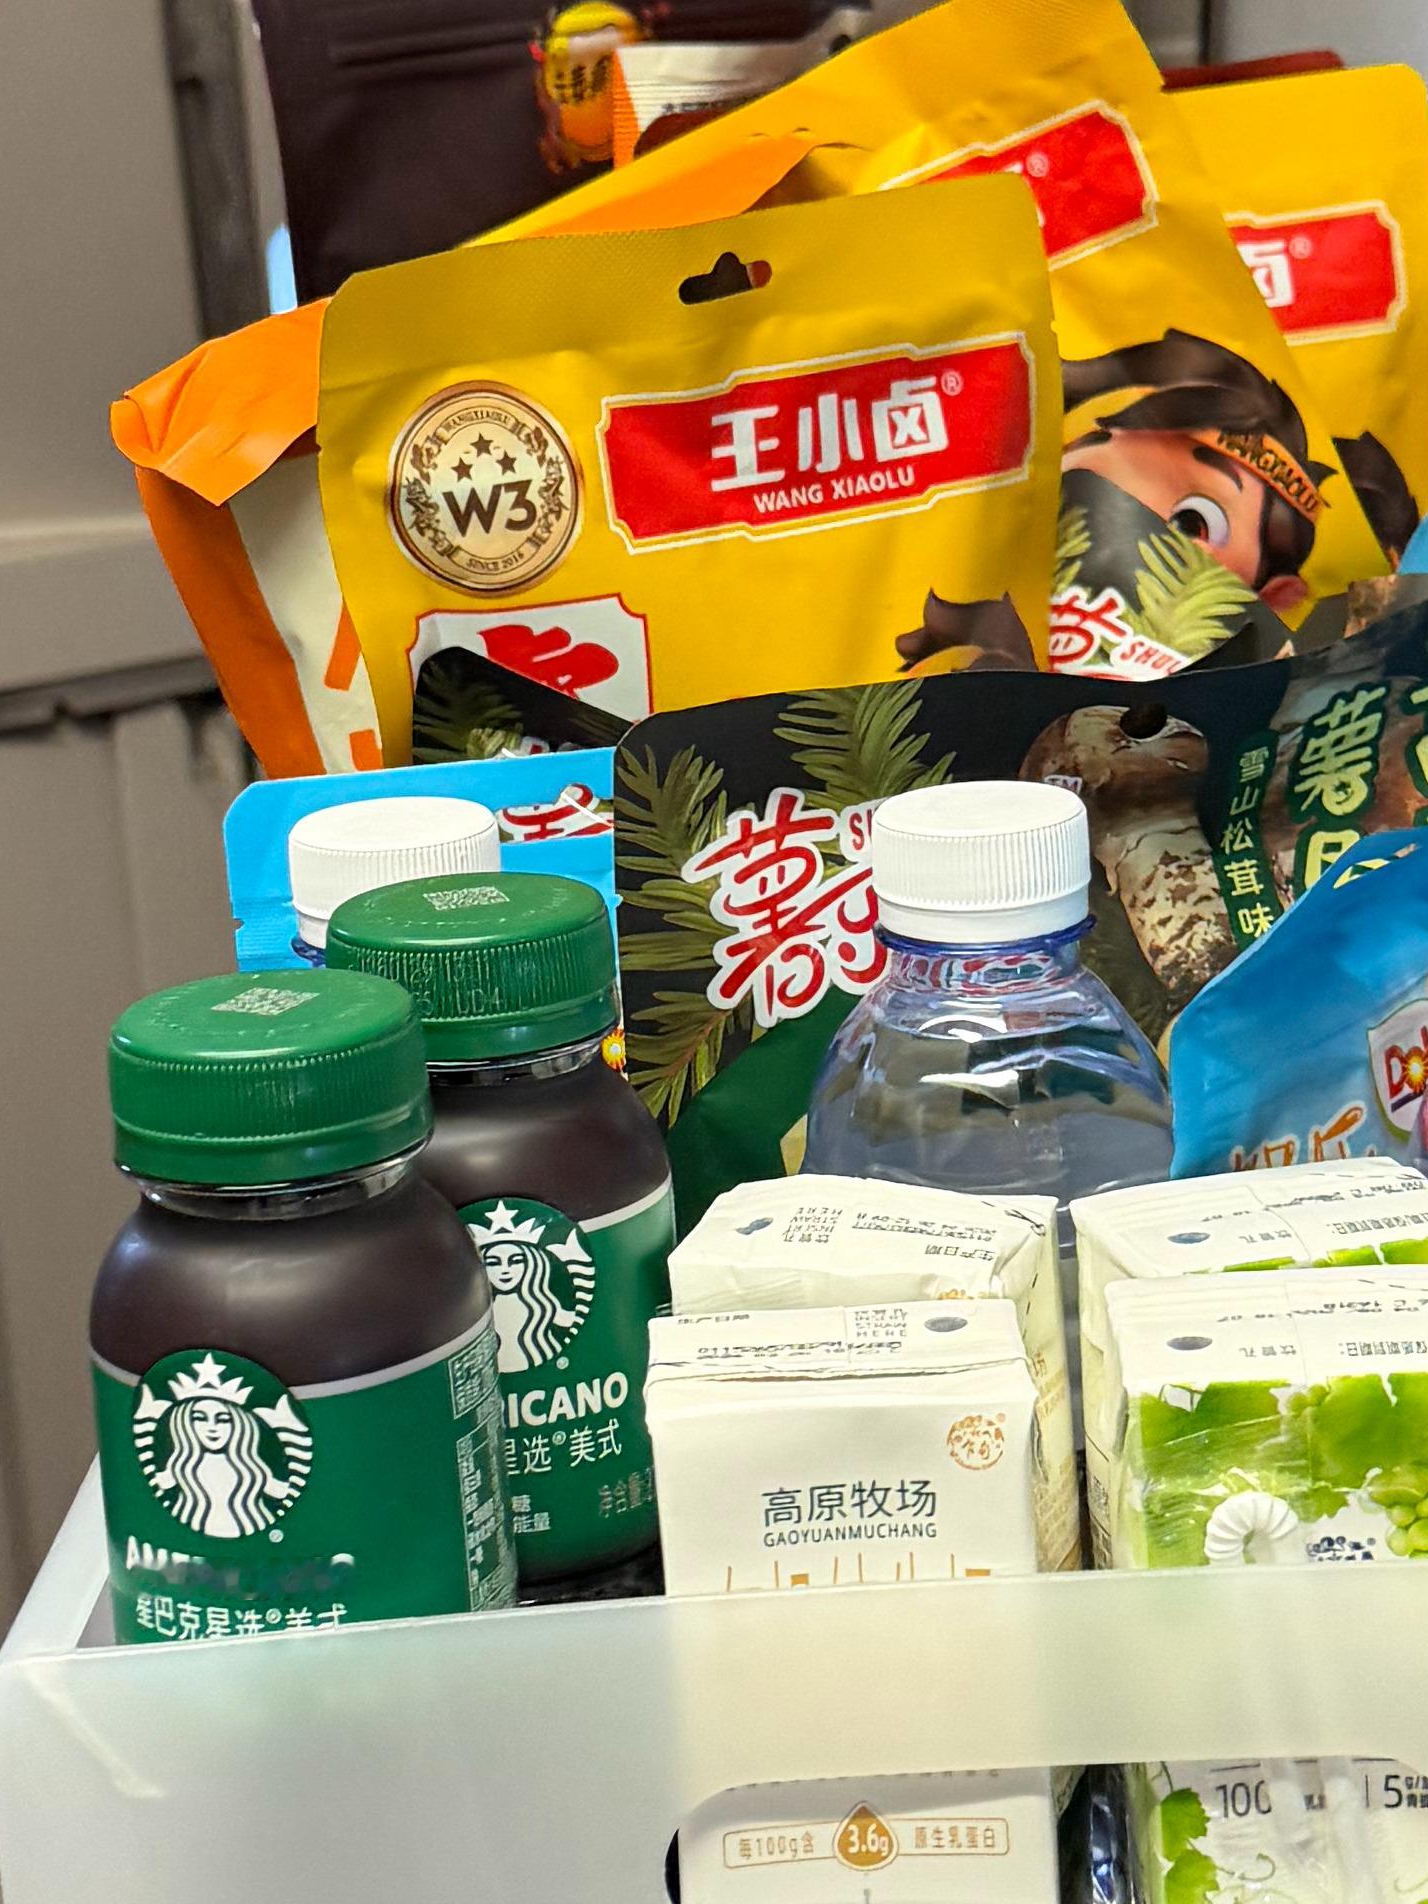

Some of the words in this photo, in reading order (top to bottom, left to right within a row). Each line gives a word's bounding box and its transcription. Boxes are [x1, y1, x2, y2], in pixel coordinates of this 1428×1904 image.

[711, 376, 949, 492] 王小卤
[442, 479, 537, 538] W3
[753, 484, 823, 513] WANG
[832, 464, 915, 500] XIAOLU
[466, 557, 500, 572] SINCE
[1220, 746, 1275, 938] 雪山松茸味
[502, 1371, 629, 1429] ICANO
[762, 1479, 937, 1528] 高原牧场
[763, 1523, 937, 1548] GAOYUANMUCHANG
[847, 1823, 889, 1854] 3.6g
